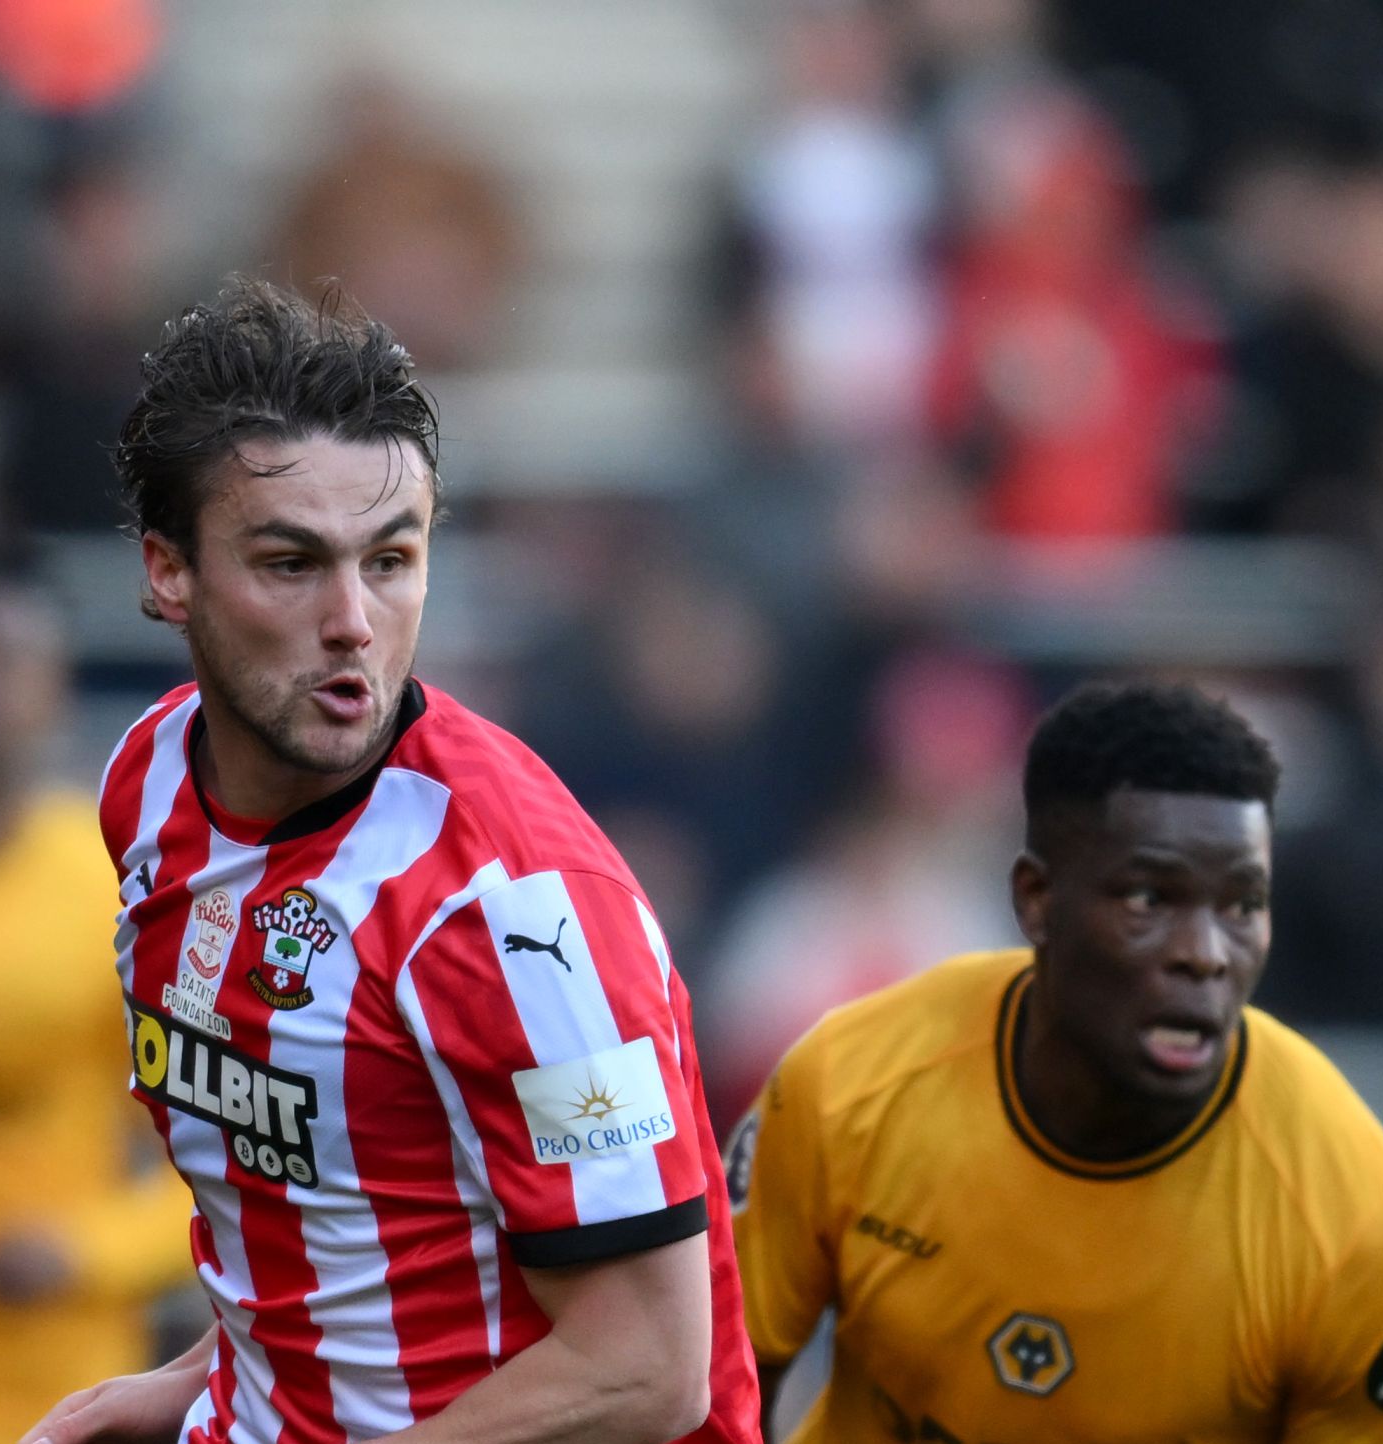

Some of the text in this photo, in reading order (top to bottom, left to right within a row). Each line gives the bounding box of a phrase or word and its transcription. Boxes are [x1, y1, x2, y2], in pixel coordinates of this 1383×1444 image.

[165, 987, 229, 1036] FOUNDATION
[181, 973, 215, 1007] SAINTS
[249, 973, 308, 1008] SOUTHAMPTON FC
[125, 1006, 306, 1145] OLLBIT
[536, 1112, 671, 1158] P&O CRUISES
